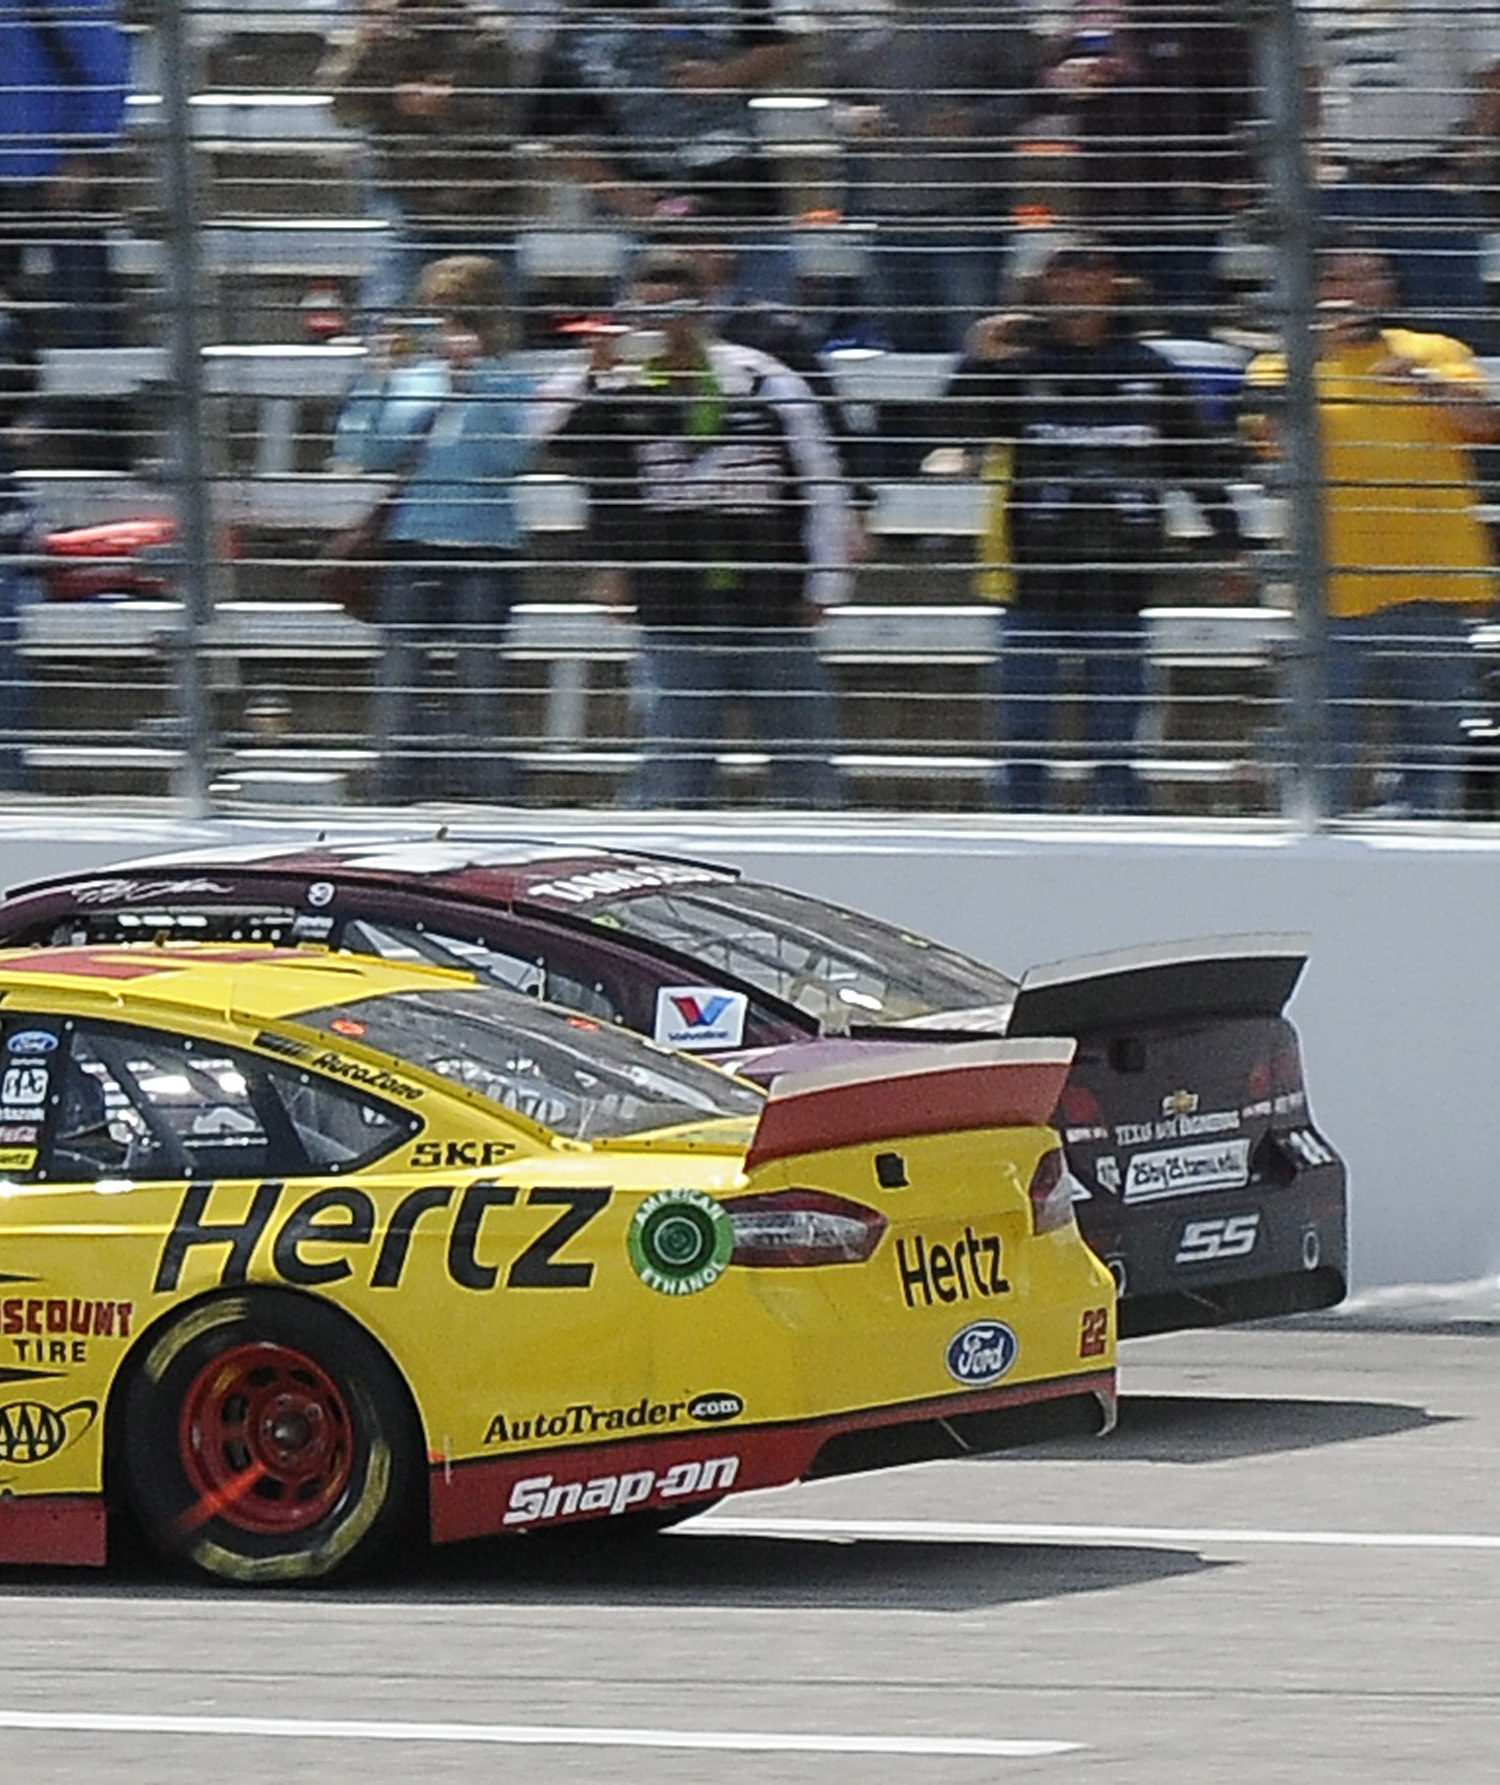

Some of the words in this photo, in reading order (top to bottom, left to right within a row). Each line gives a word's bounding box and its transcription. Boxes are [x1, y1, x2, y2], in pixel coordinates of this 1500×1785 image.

[312, 1052, 425, 1100] AutoZone
[411, 1142, 516, 1166] SKF
[635, 1188, 726, 1224] AMERICAN
[153, 1178, 613, 1293] Hertz
[640, 1261, 726, 1294] ETHANOL
[896, 1227, 1011, 1307] Hertz
[13, 1339, 87, 1363] TIRE
[956, 1329, 1006, 1376] Ford
[502, 1456, 740, 1525] Snap-on
